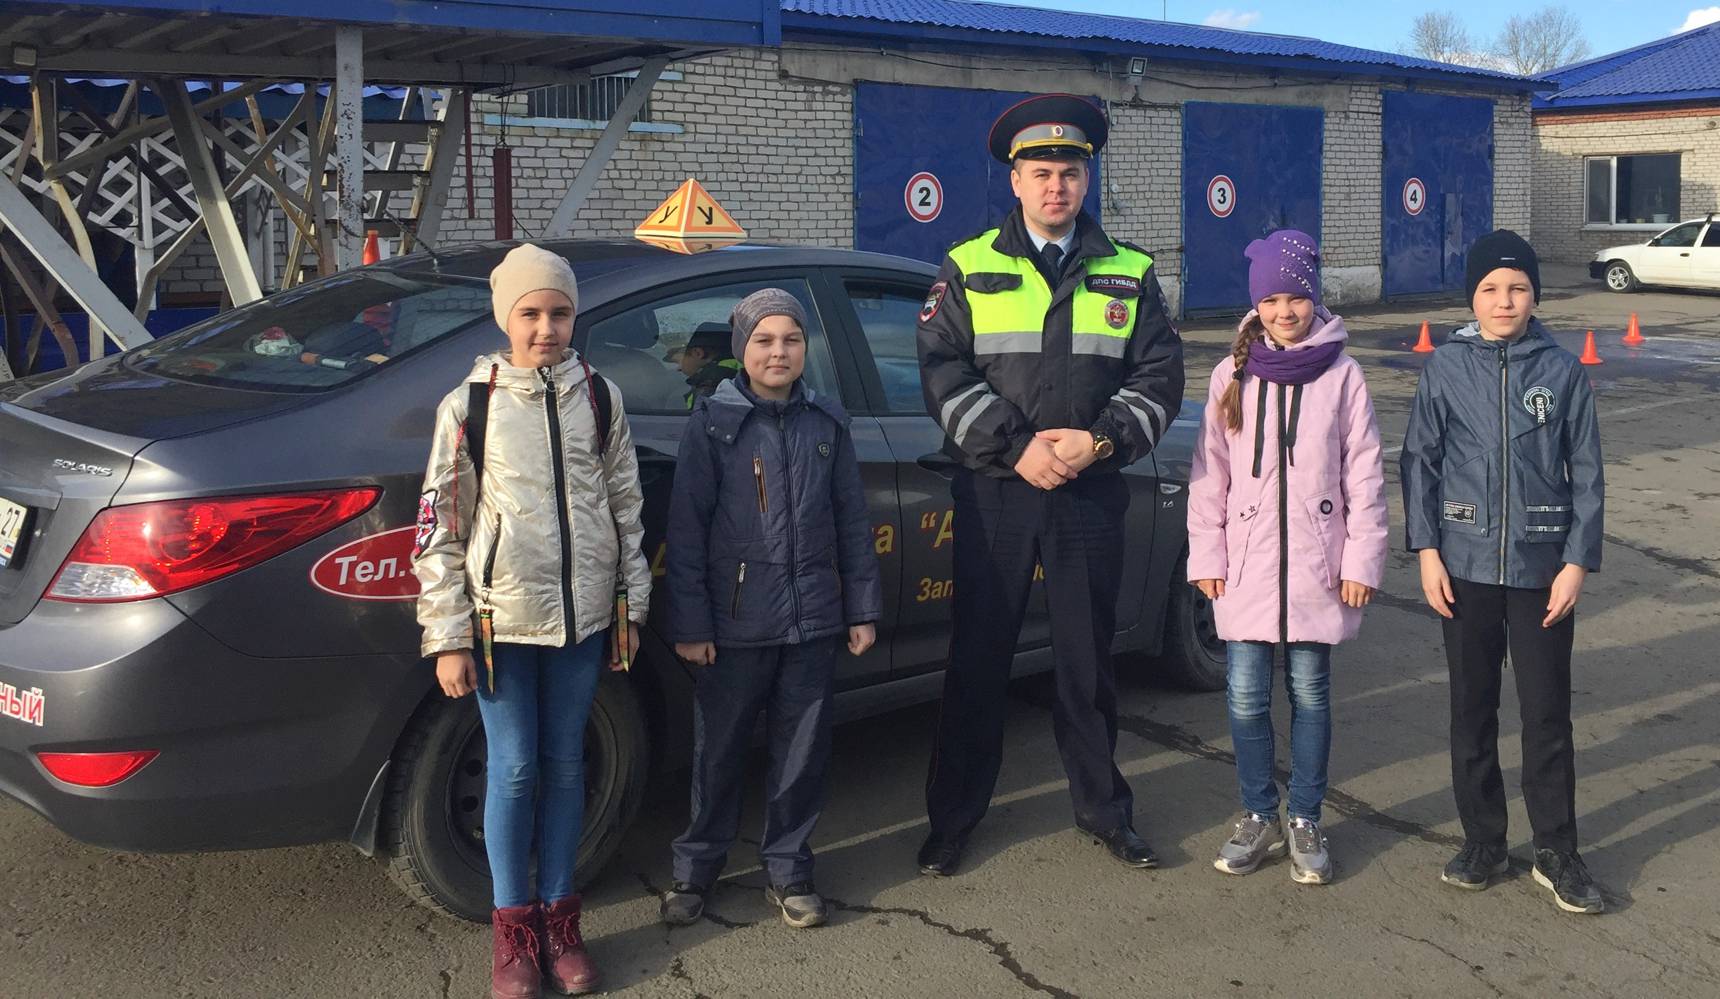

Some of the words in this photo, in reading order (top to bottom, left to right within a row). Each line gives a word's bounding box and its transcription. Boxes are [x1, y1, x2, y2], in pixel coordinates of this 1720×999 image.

[918, 186, 932, 207] 2
[1217, 187, 1227, 205] 3
[1409, 189, 1418, 204] 4
[1092, 278, 1109, 286] ДПС
[1110, 278, 1137, 289] ГИБДД
[52, 457, 113, 478] SOLARIS
[334, 555, 406, 586] Тел.
